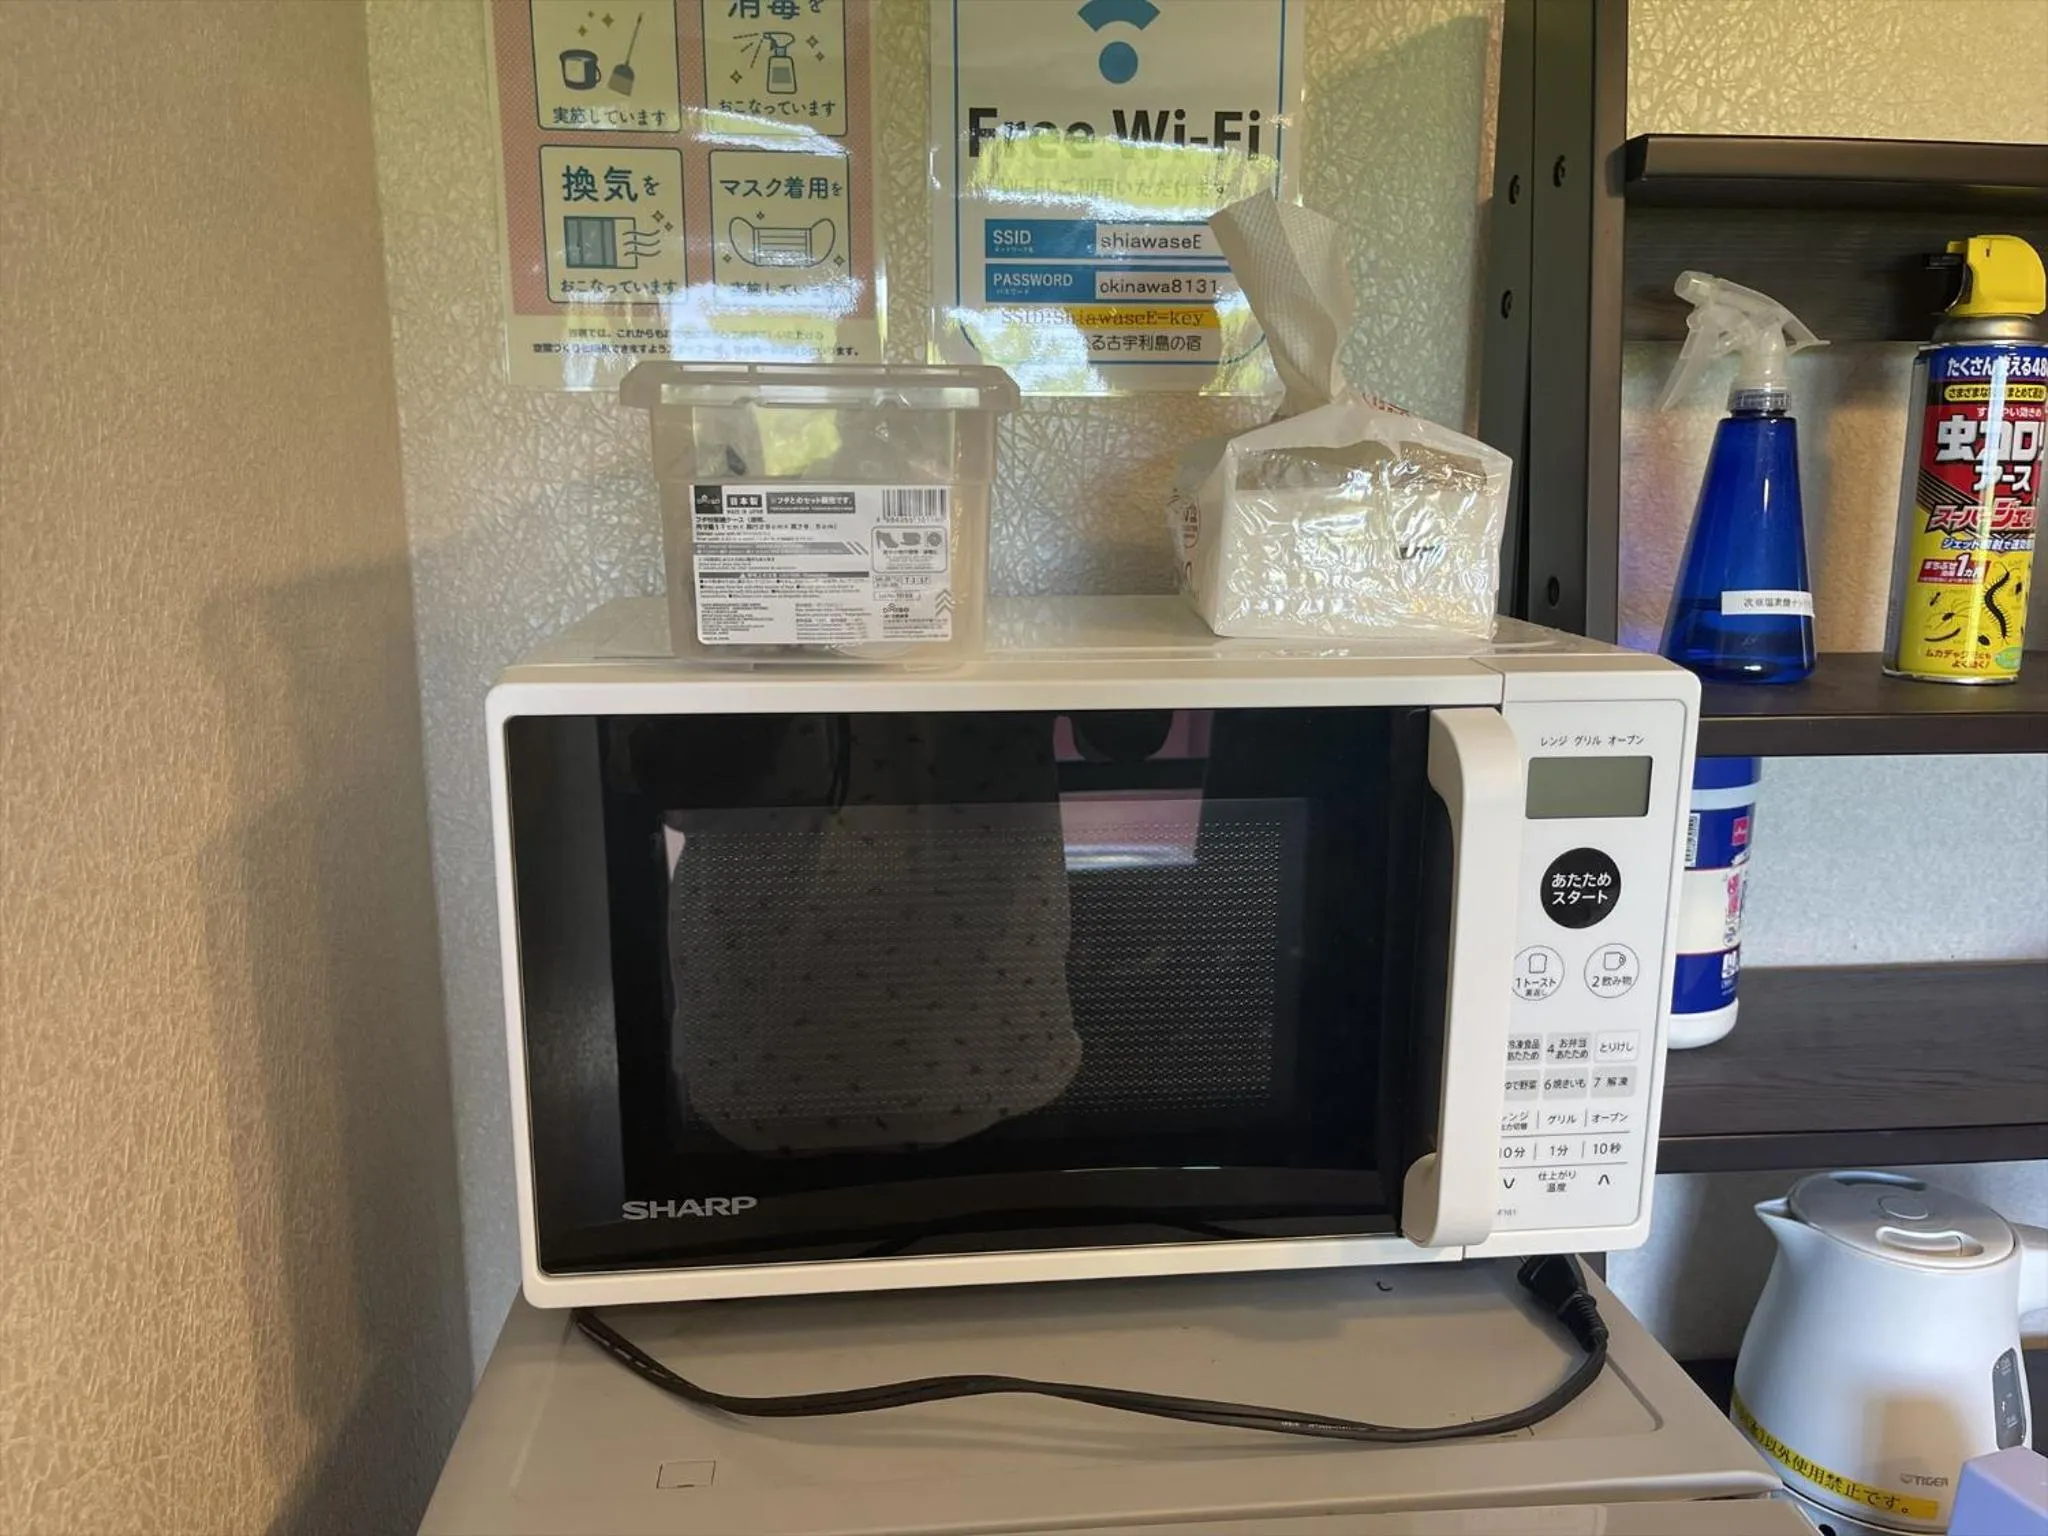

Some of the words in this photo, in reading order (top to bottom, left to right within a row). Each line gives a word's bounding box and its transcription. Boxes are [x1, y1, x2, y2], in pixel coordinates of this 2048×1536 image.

[718, 99, 836, 118] おこなっています
[552, 107, 668, 126] 実施しています
[561, 165, 660, 204] 換気を
[719, 177, 843, 200] マスク着用を
[992, 230, 1032, 245] SSID
[1101, 234, 1202, 249] shiawaseE
[559, 278, 677, 296] おこなっています
[993, 273, 1073, 287] PASSWORD
[1100, 279, 1217, 294] okinawa8131
[1540, 735, 1567, 747] レンジ
[1574, 735, 1601, 746] グリル
[1608, 734, 1645, 746] オープン
[1551, 872, 1612, 889] あたため
[1552, 889, 1609, 905] スタート
[1523, 977, 1557, 988] トースト
[1602, 976, 1632, 987] 飲み物
[1600, 1042, 1634, 1053] とりけし
[1556, 1050, 1588, 1060] あたため
[1547, 1113, 1577, 1125] グリル
[1591, 1111, 1629, 1123] オープン
[1550, 1145, 1569, 1157] 1分
[1593, 1143, 1622, 1155] 10秒
[1538, 1170, 1577, 1181] 仕上がり
[622, 1196, 757, 1220] SHARP
